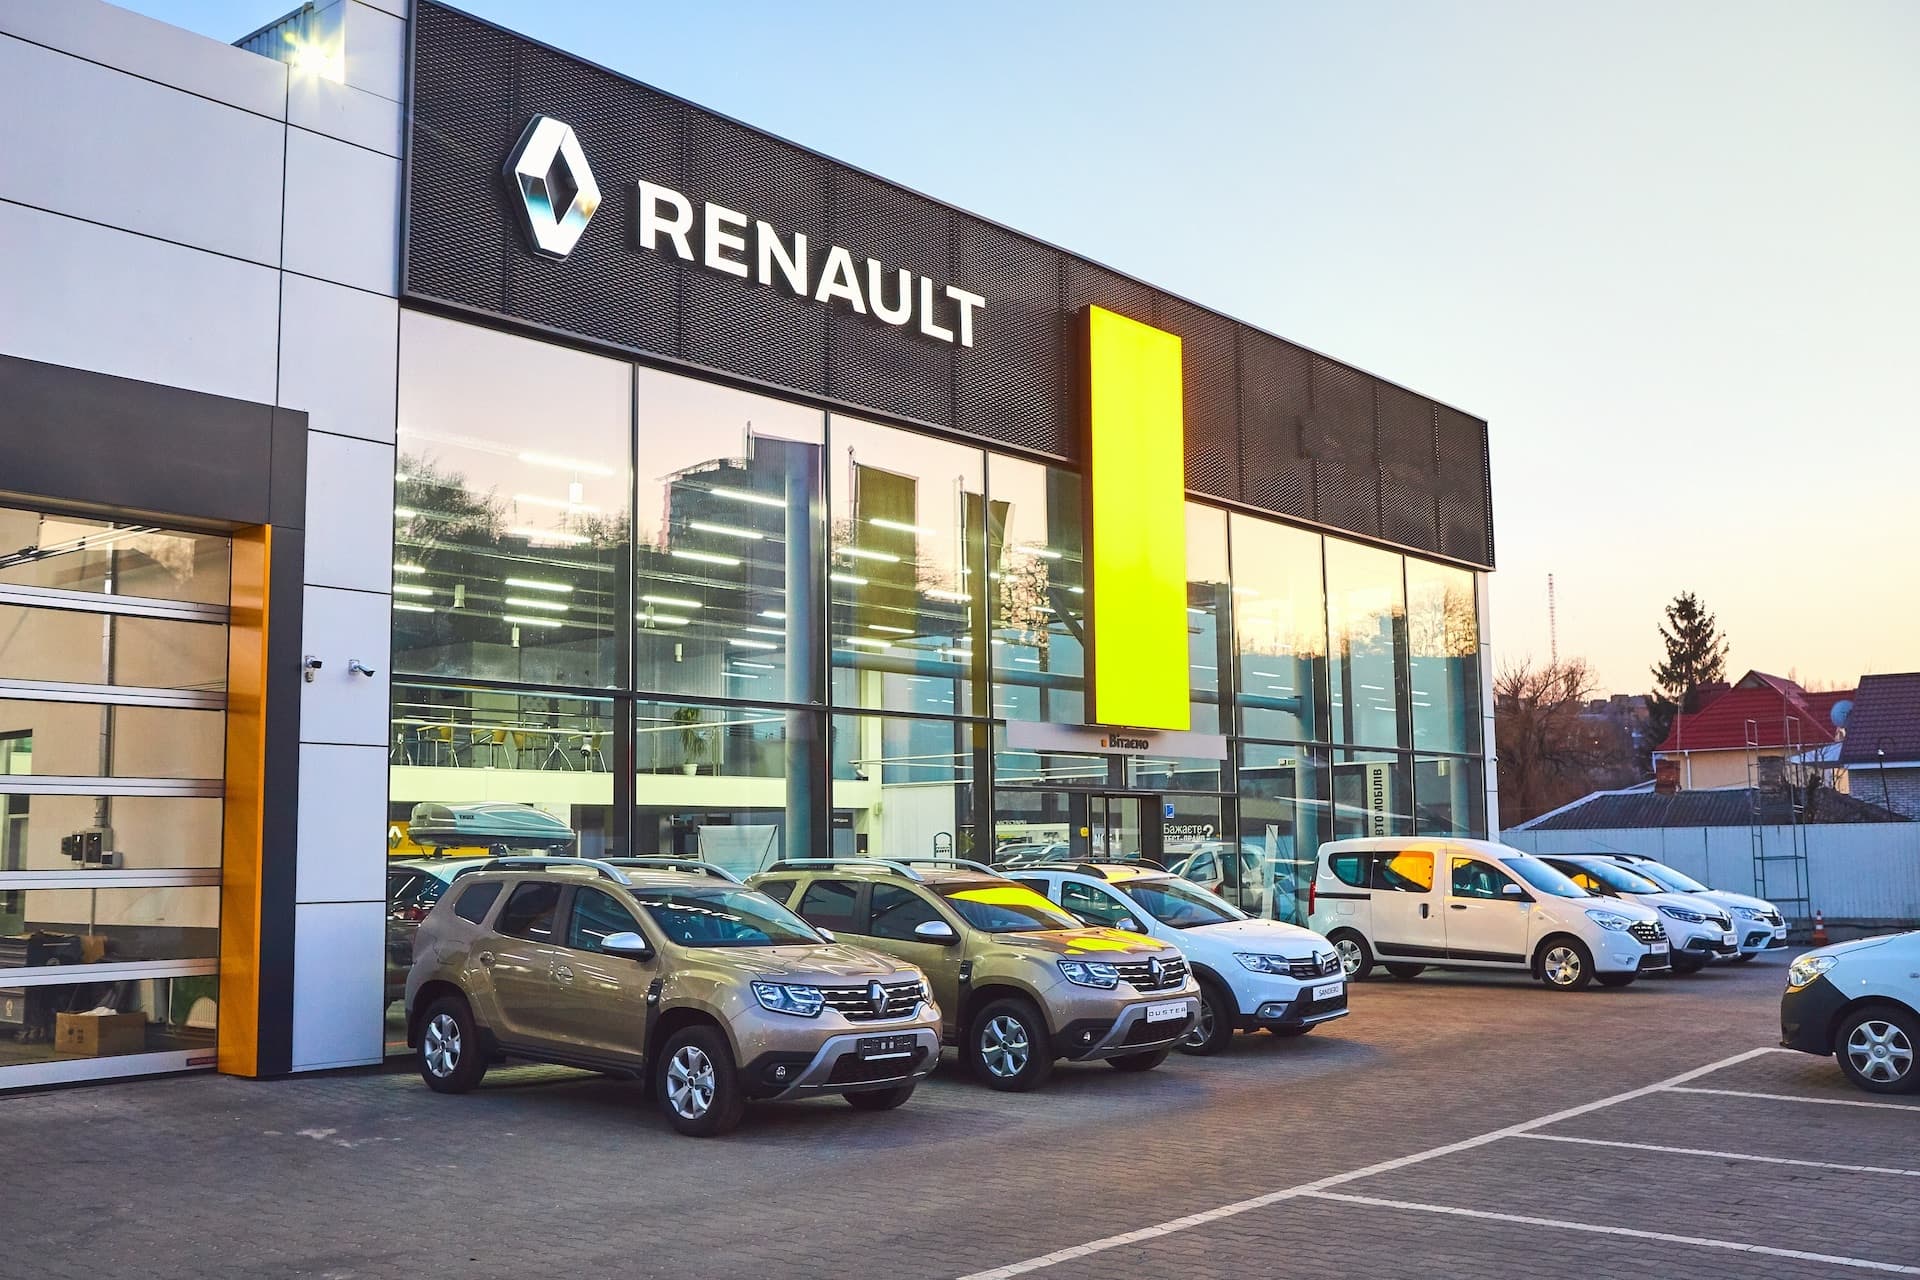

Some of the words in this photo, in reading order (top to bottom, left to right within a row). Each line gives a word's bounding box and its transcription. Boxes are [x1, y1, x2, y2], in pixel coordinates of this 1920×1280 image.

[638, 179, 985, 348] RENAULT
[1373, 768, 1385, 837] ВТОМОБІЛІВ
[1149, 1007, 1186, 1017] DUSTER
